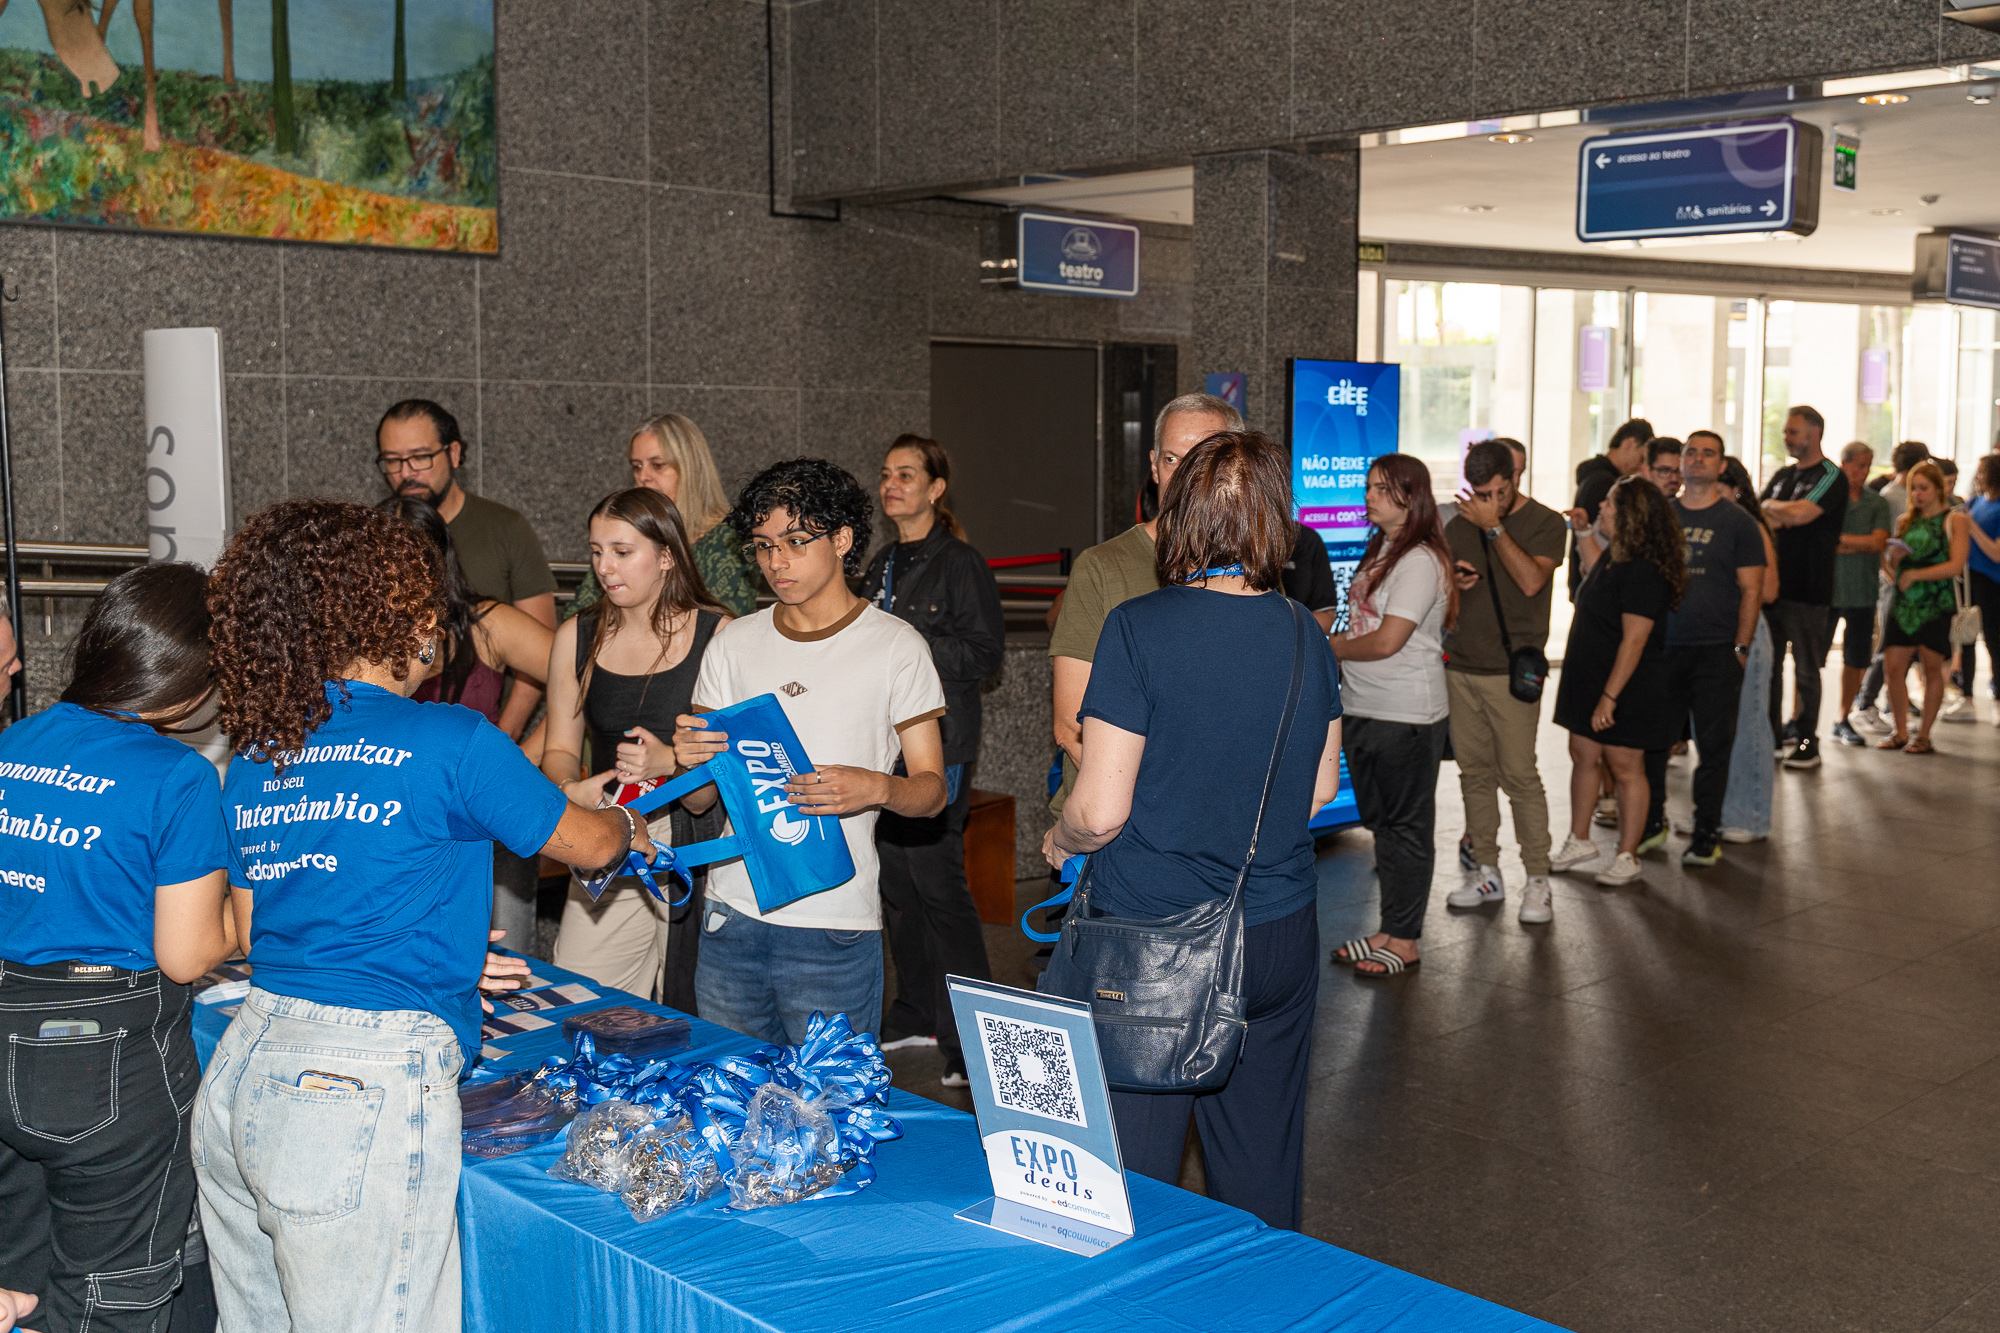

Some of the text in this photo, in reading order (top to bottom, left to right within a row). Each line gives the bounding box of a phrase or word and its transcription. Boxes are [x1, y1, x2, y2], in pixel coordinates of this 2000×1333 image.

[1617, 149, 1691, 164] acesso ao teatro
[1706, 203, 1752, 217] sanitários
[1059, 261, 1104, 280] teatro
[1302, 454, 1330, 471] NÃO
[1331, 456, 1365, 471] DEIXE
[1303, 473, 1367, 489] VAGA ESFR
[263, 775, 305, 793] no seu
[234, 792, 402, 831] Intercâmbio?
[1010, 1135, 1078, 1180] EXPO
[1024, 1170, 1093, 1200] deals
[1057, 1200, 1111, 1220] edcommerce
